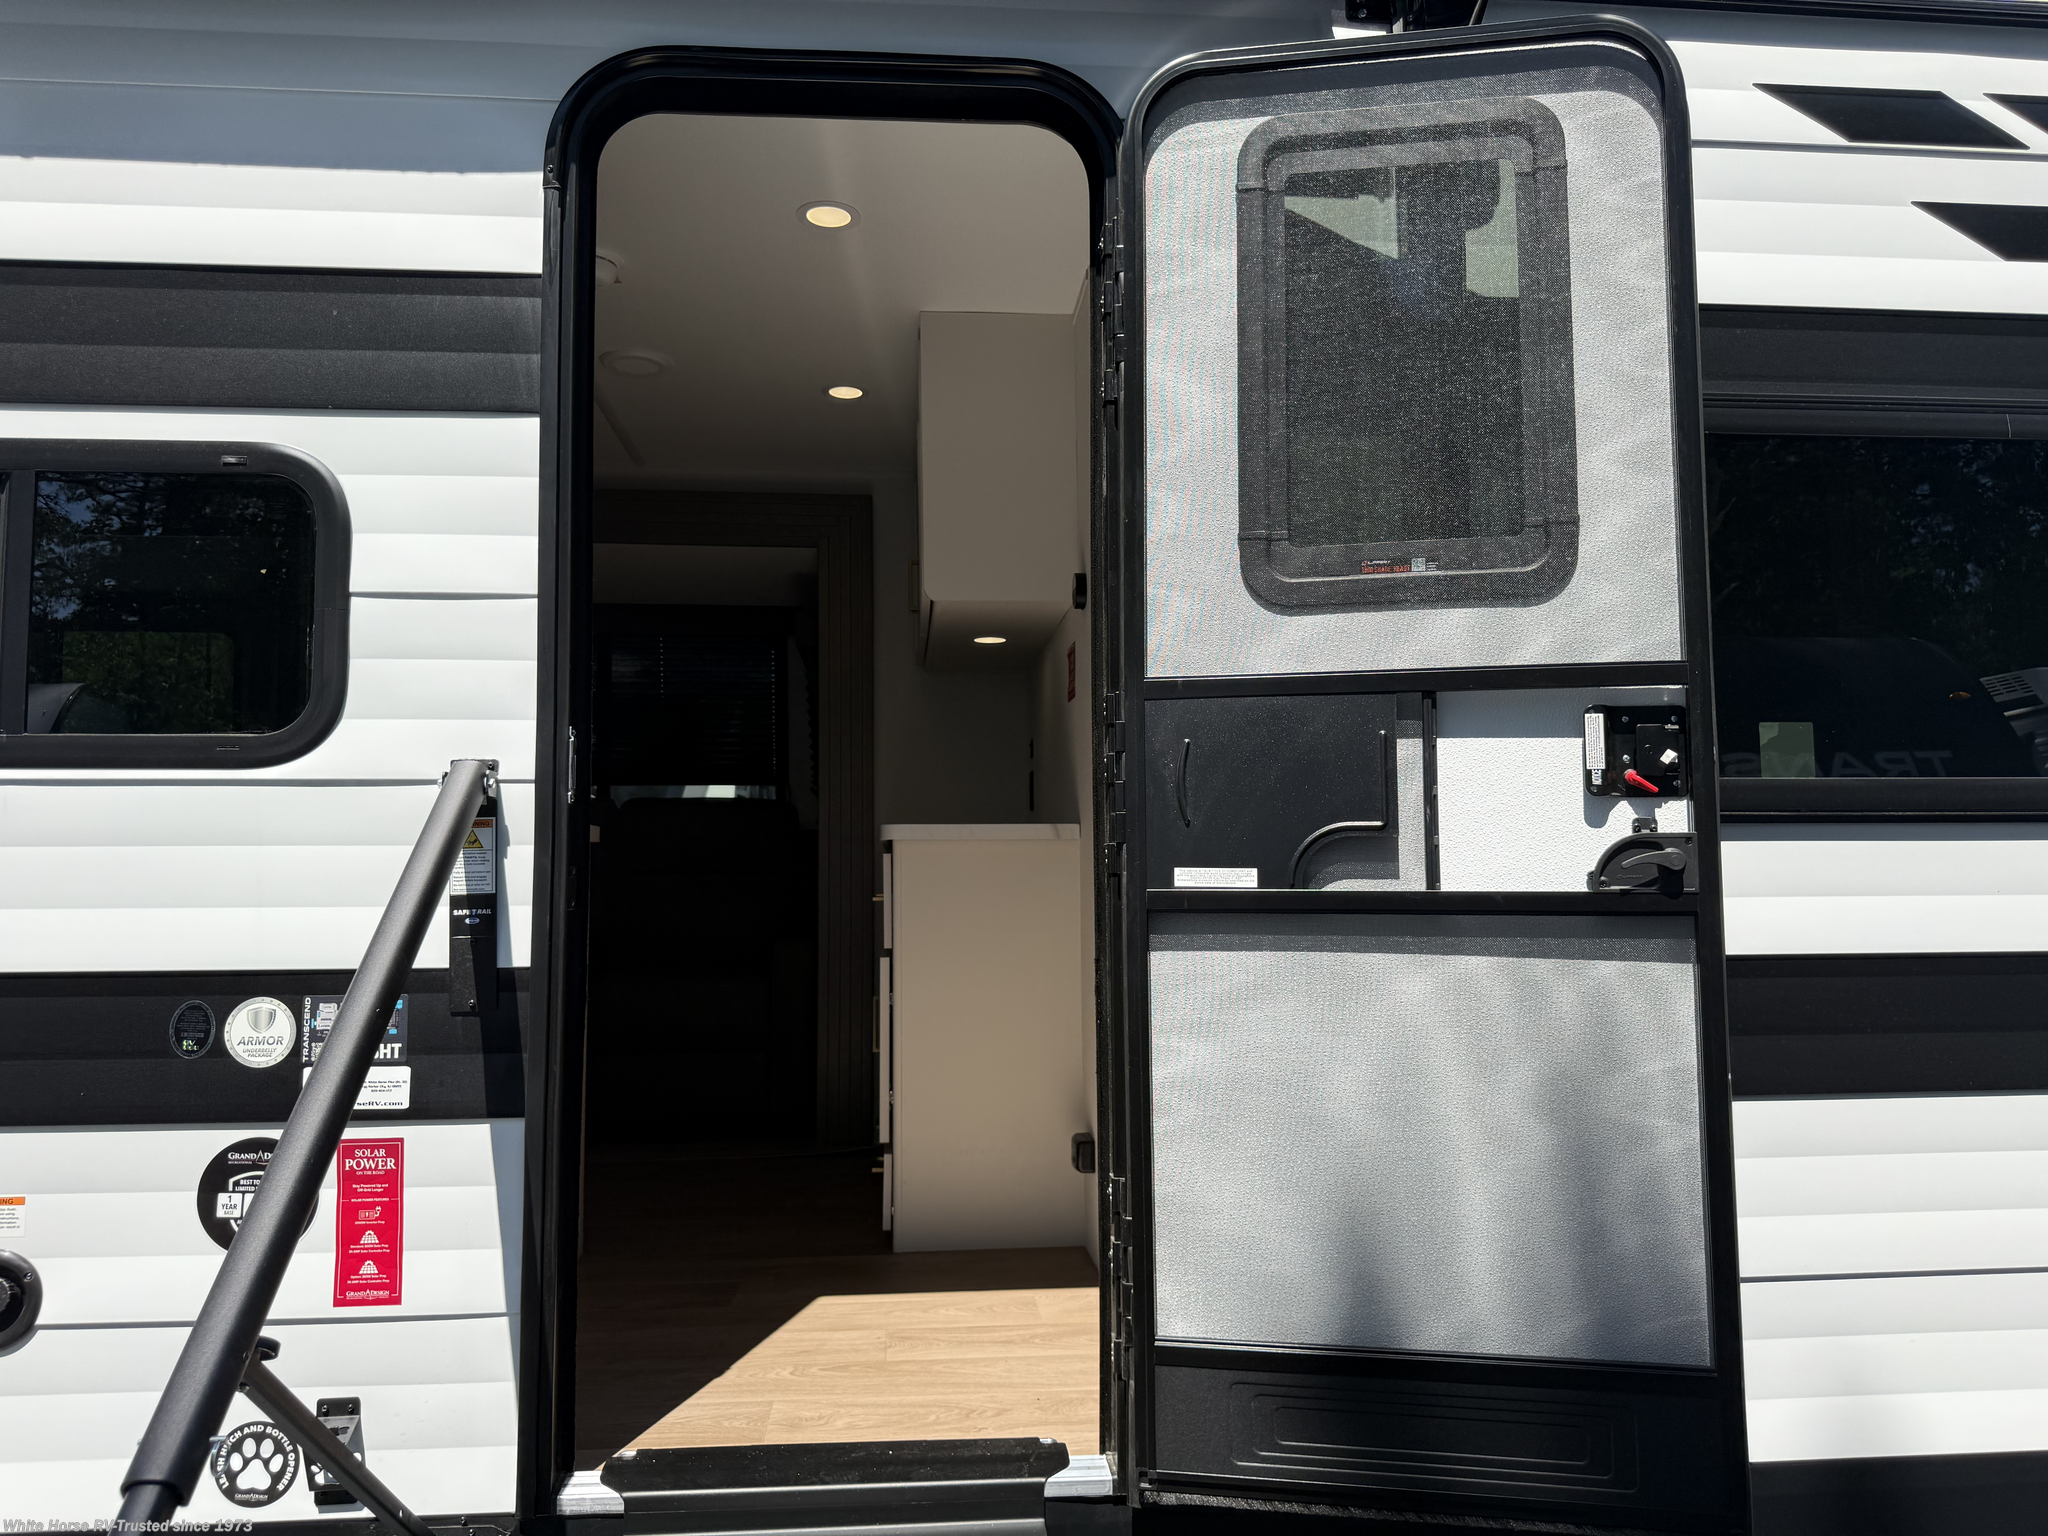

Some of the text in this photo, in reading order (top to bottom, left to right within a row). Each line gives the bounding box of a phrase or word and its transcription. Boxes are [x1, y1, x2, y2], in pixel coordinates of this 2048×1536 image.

[302, 997, 312, 1063] TRANSCEND
[237, 1035, 284, 1046] ARMOR
[228, 1152, 257, 1160] GRAND
[354, 1148, 387, 1157] SOLAR
[345, 1158, 397, 1170] POWER
[243, 1425, 265, 1435] AND
[265, 1426, 294, 1452] BOTTLE
[217, 1457, 229, 1489] LESH
[276, 1452, 296, 1491] OPENER
